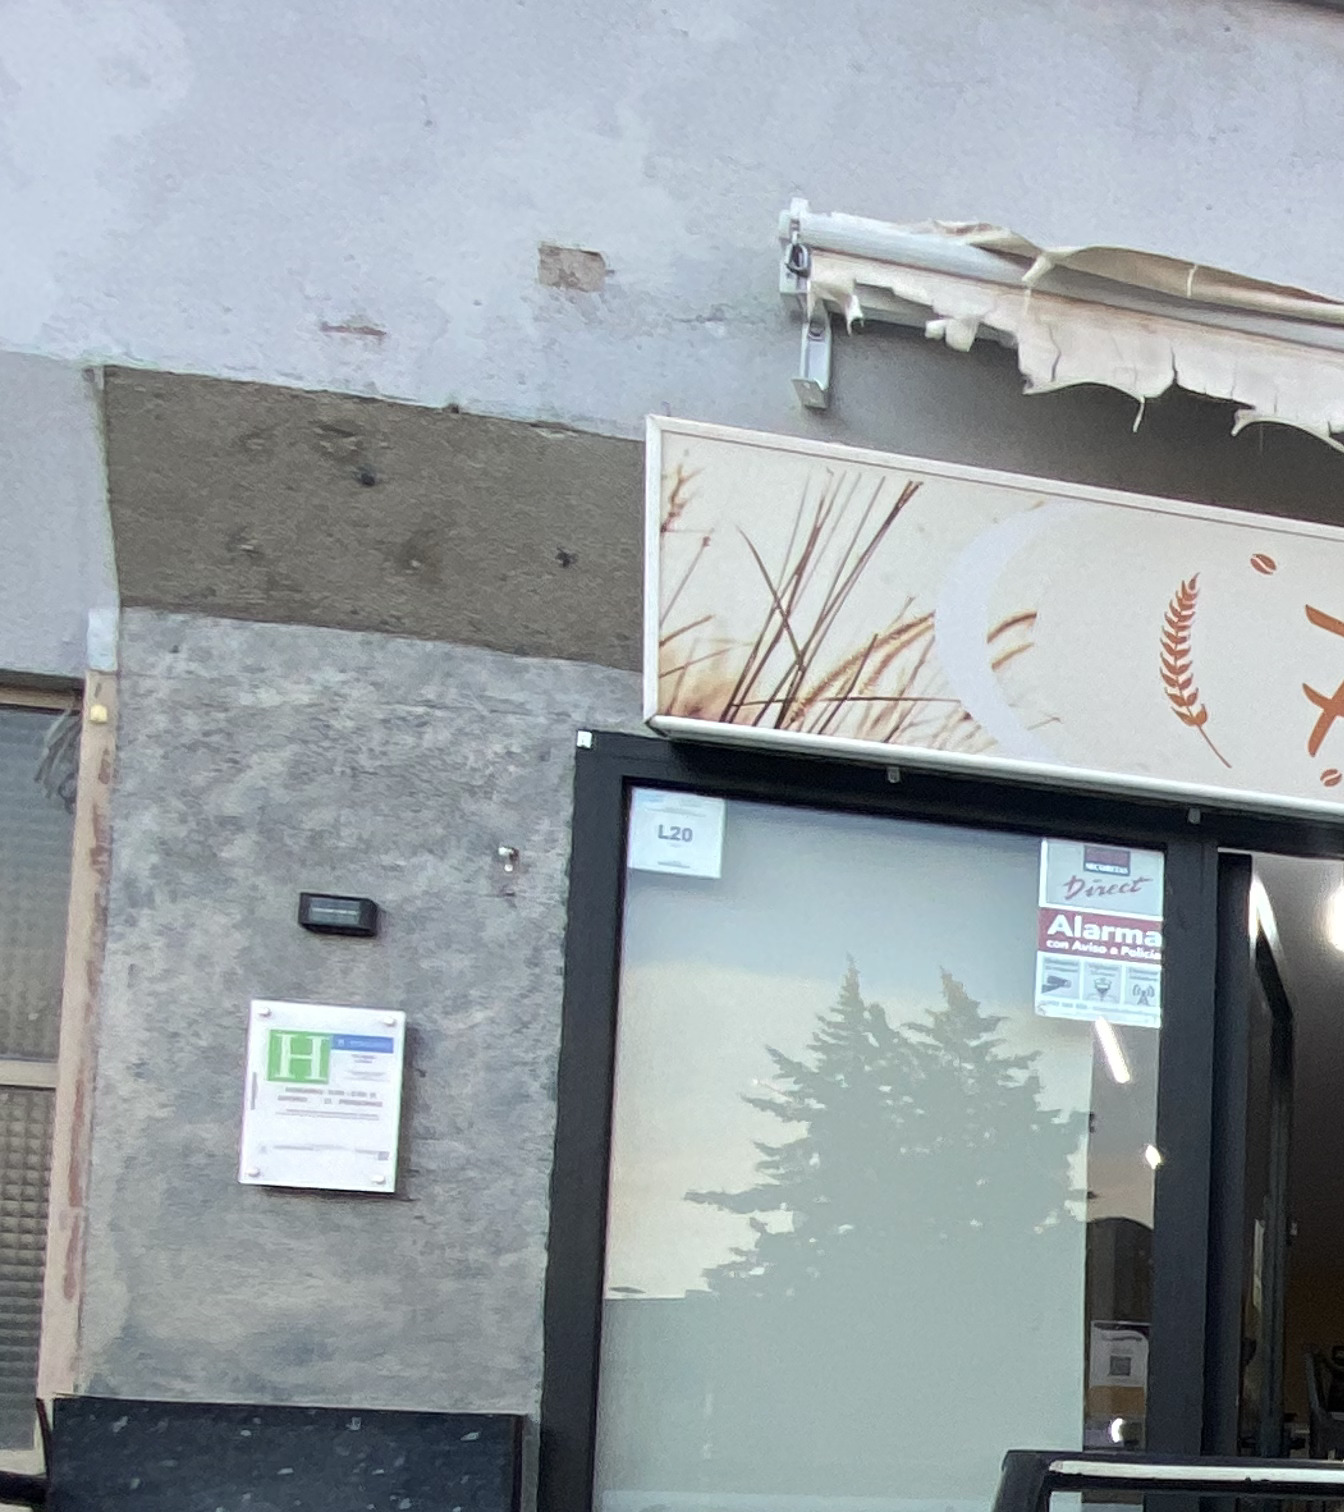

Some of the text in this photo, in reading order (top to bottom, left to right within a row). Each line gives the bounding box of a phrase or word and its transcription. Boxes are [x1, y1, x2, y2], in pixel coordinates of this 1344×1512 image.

[658, 824, 693, 842] L20
[1062, 874, 1154, 900] Direct
[1047, 914, 1163, 948] Alarma
[1046, 939, 1069, 950] con
[1071, 940, 1108, 954] Aviso
[273, 1033, 331, 1080] H
